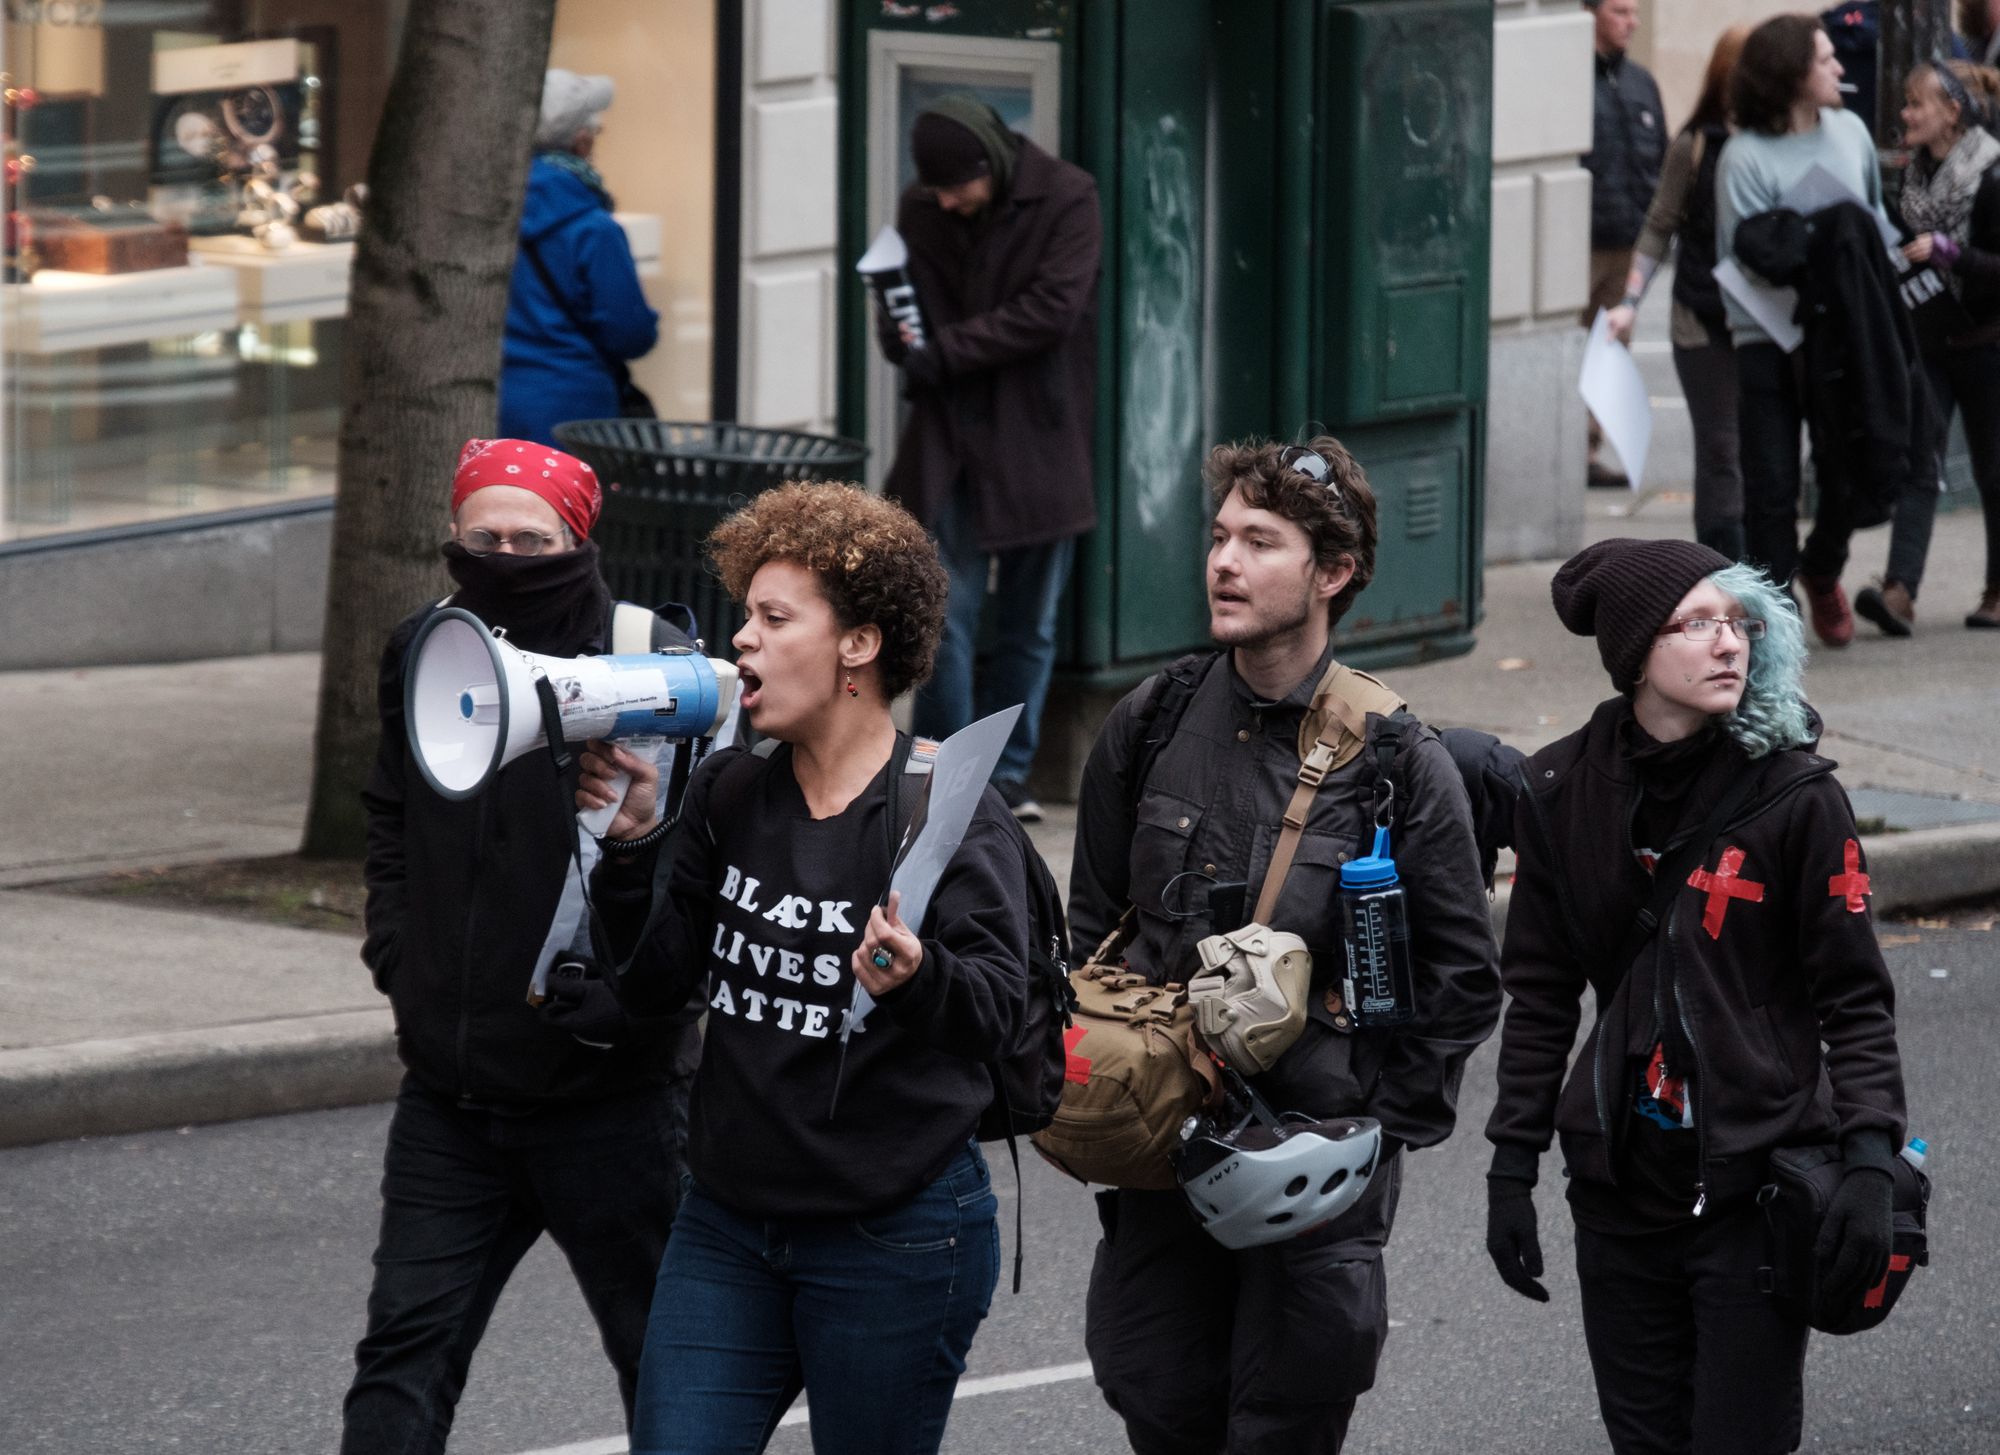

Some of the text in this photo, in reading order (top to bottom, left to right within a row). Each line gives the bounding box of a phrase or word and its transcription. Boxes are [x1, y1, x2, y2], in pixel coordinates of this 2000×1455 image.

[640, 695, 658, 703] Seattle
[718, 864, 855, 934] BLACK
[711, 922, 841, 986] LIVES
[710, 979, 867, 1038] ATTE
[1207, 1161, 1240, 1186] CAMP
